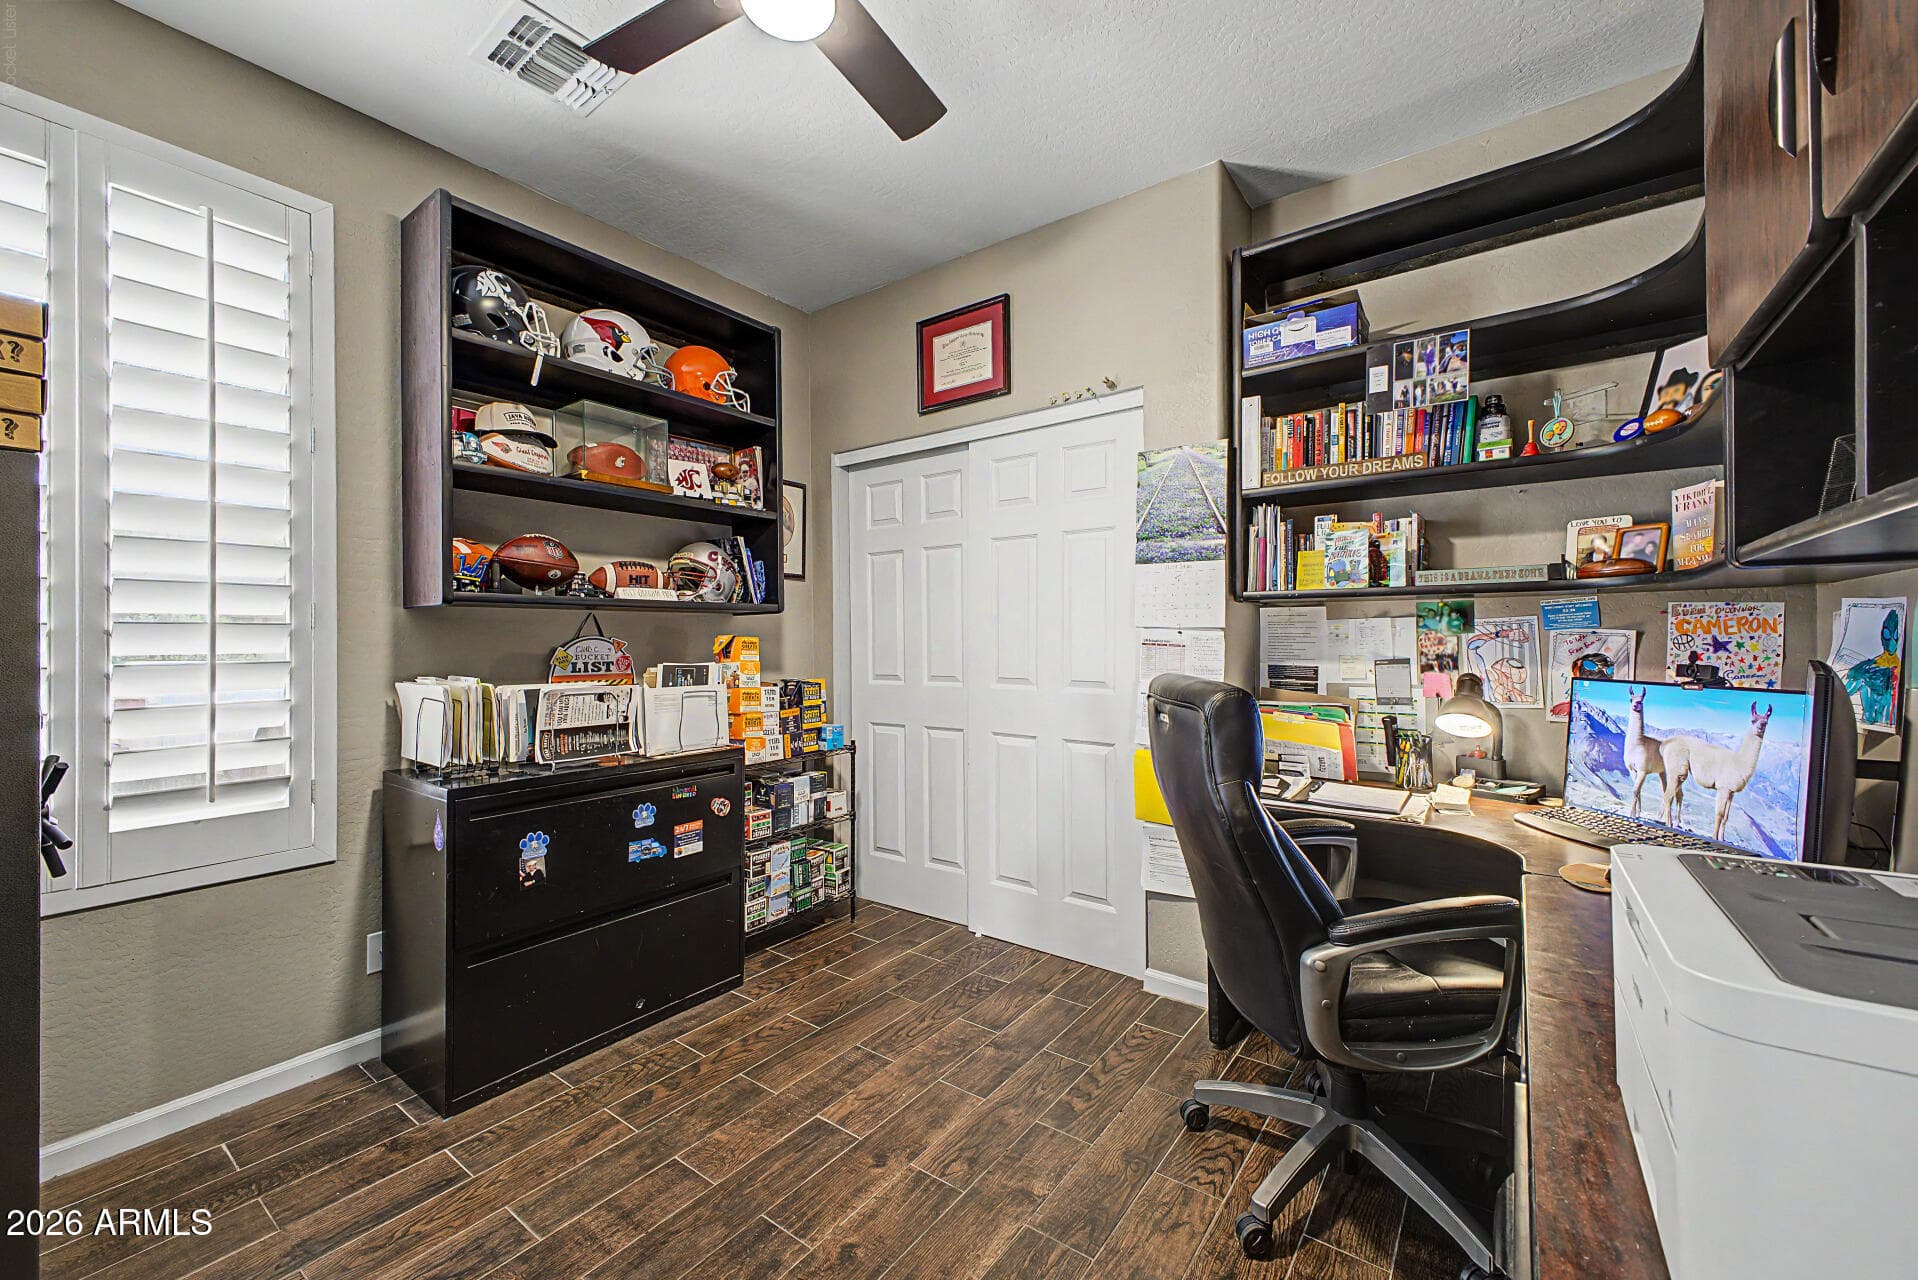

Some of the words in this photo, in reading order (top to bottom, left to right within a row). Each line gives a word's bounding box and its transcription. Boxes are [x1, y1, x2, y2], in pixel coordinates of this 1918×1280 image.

[1263, 468, 1318, 486] FOLLOW
[1319, 463, 1358, 480] YOUR
[1362, 454, 1424, 475] DREAMS
[629, 574, 650, 585] HIT
[1674, 615, 1779, 636] CAMERON
[574, 653, 611, 661] BUCKET
[570, 661, 615, 674] LIST
